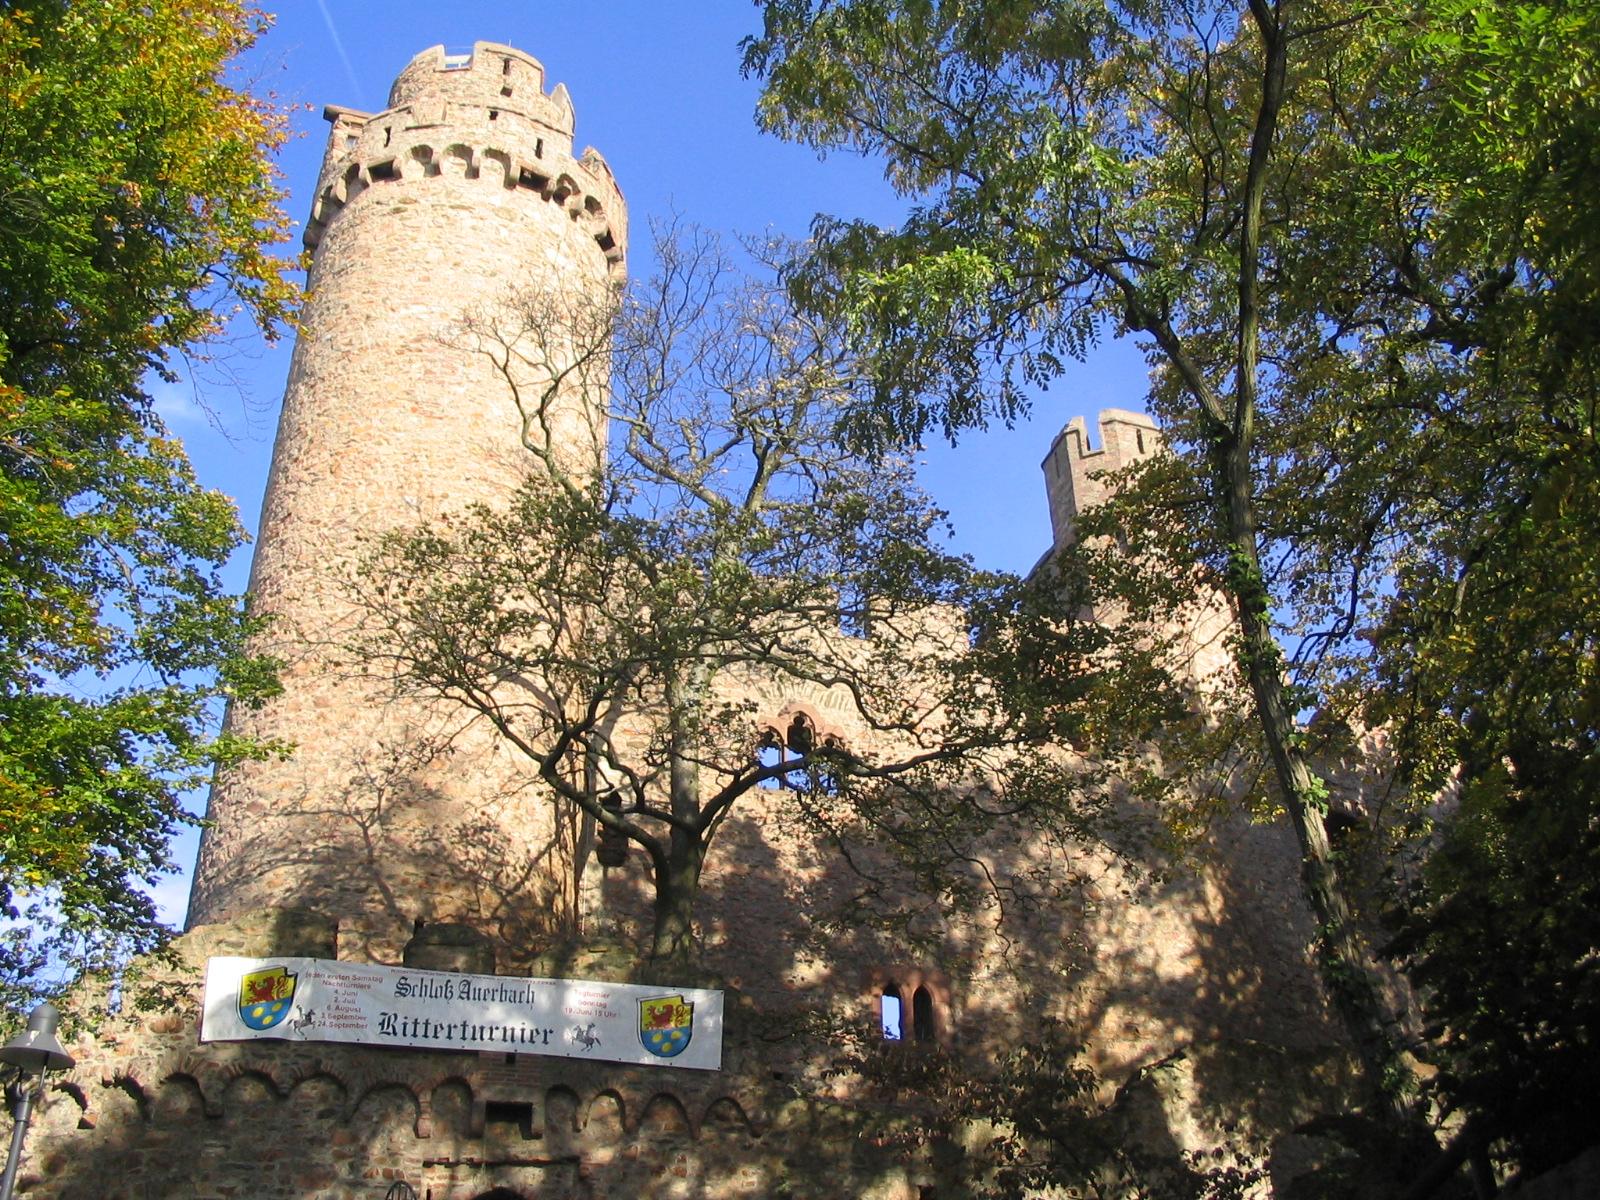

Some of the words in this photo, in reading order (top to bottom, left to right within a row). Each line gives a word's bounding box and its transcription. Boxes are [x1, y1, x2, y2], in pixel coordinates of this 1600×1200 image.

[351, 974, 384, 983] Samstag
[394, 976, 454, 1004] Schloß
[457, 979, 535, 1010] Auerbach
[335, 1005, 361, 1013] August
[327, 1013, 368, 1021] September
[603, 1010, 617, 1018] Uhr
[328, 1021, 368, 1029] September
[378, 1011, 555, 1045] Ritterturnier
